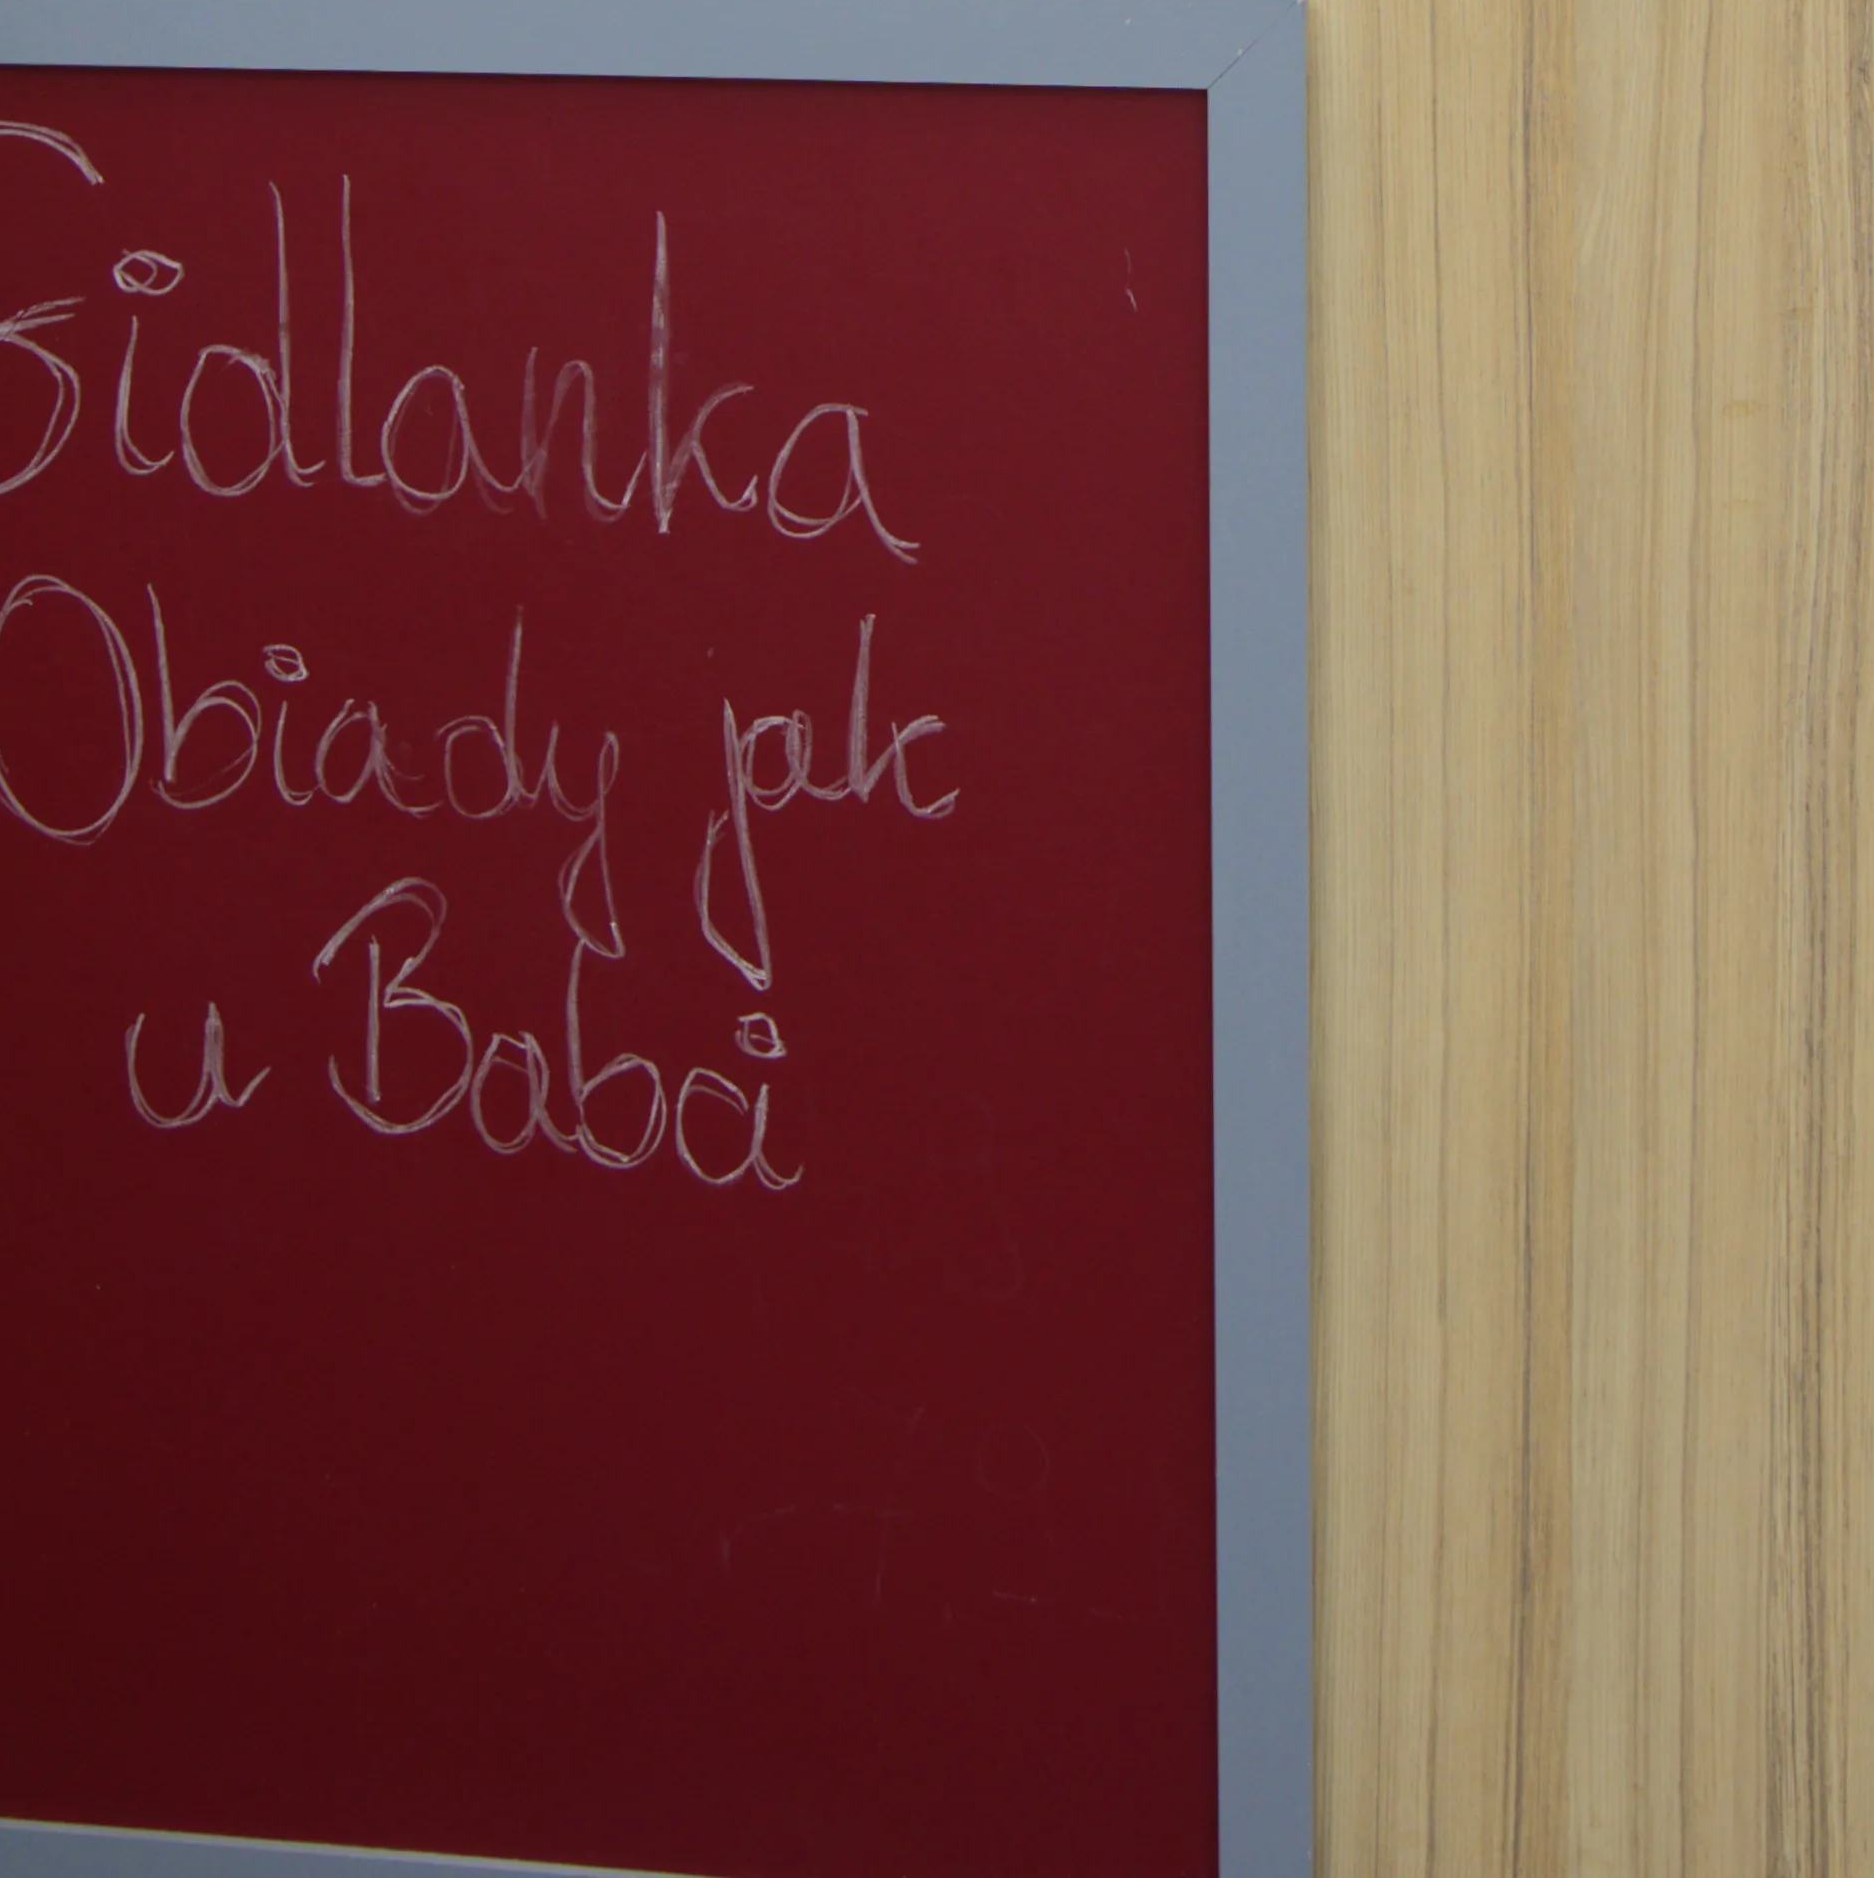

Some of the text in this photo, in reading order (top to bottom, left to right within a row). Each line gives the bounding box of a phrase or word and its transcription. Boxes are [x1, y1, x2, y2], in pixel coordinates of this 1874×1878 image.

[693, 612, 961, 992] jak
[125, 876, 805, 1191] u Babci
